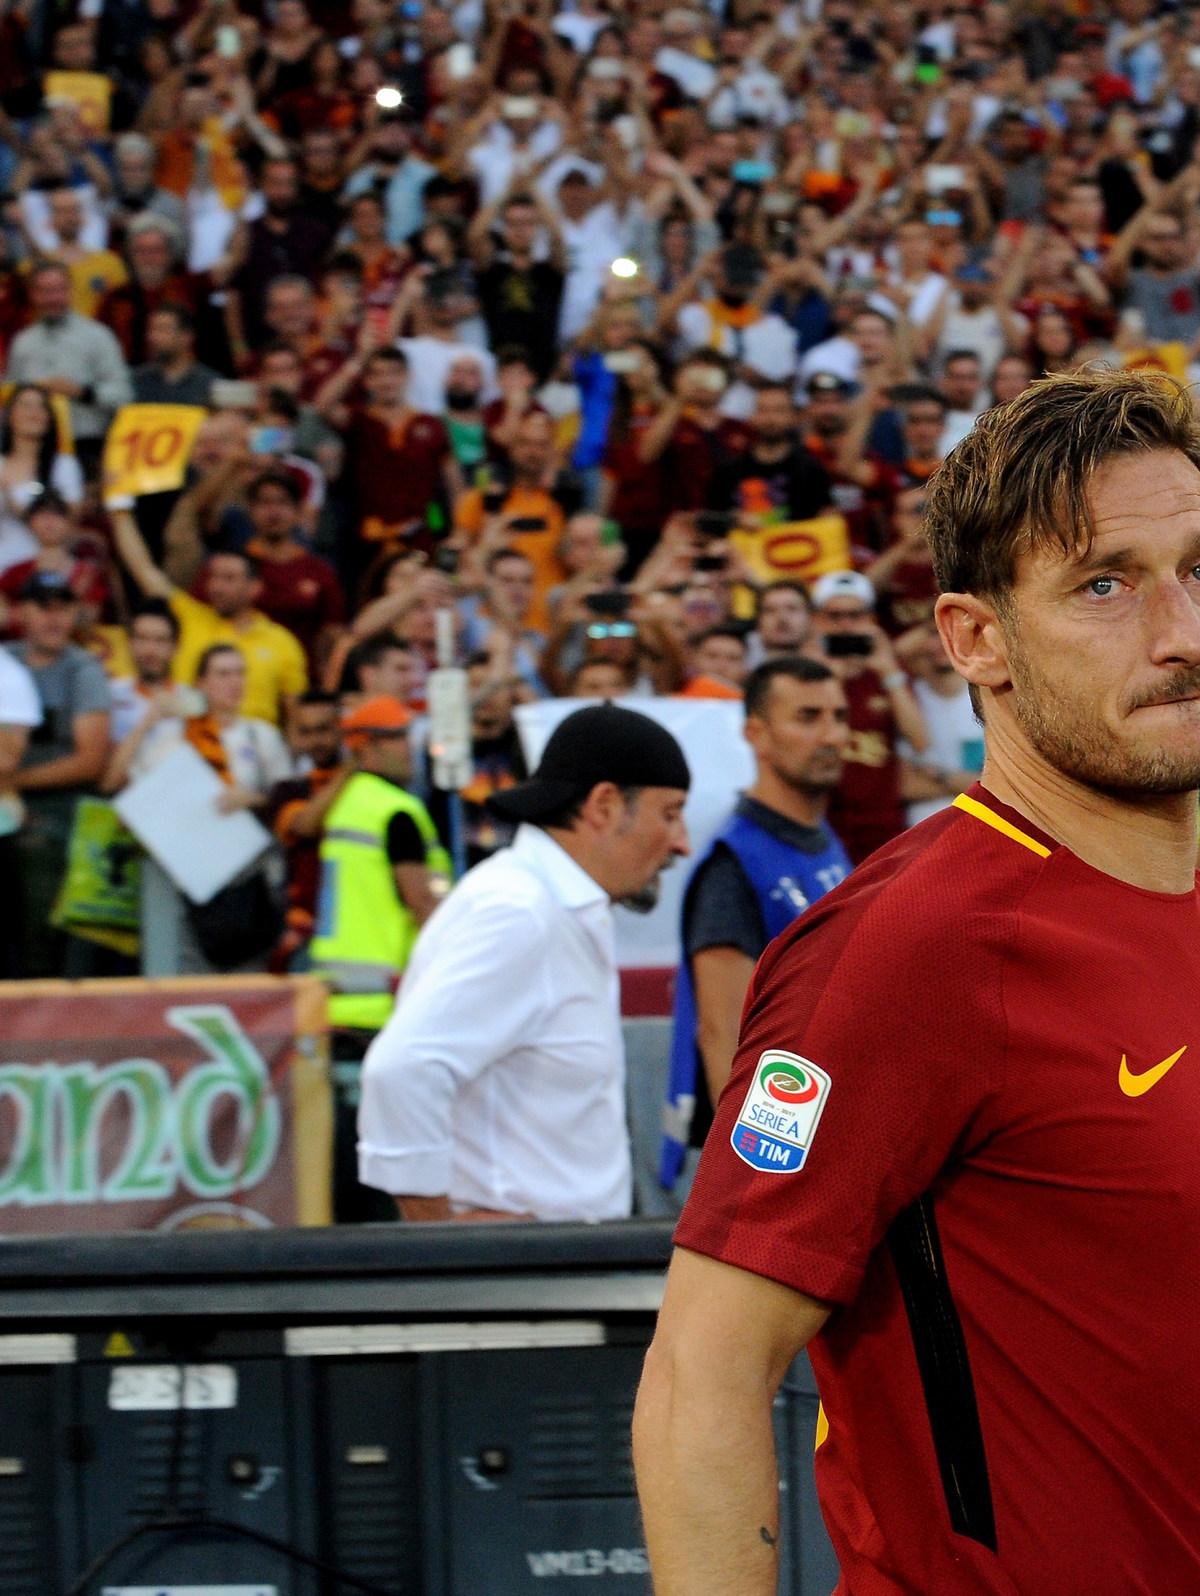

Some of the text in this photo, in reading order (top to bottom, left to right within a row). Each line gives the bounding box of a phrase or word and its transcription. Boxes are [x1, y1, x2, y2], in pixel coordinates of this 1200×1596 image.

[117, 426, 184, 472] 10
[748, 1104, 798, 1138] SERIE A
[759, 1139, 790, 1165] TIM
